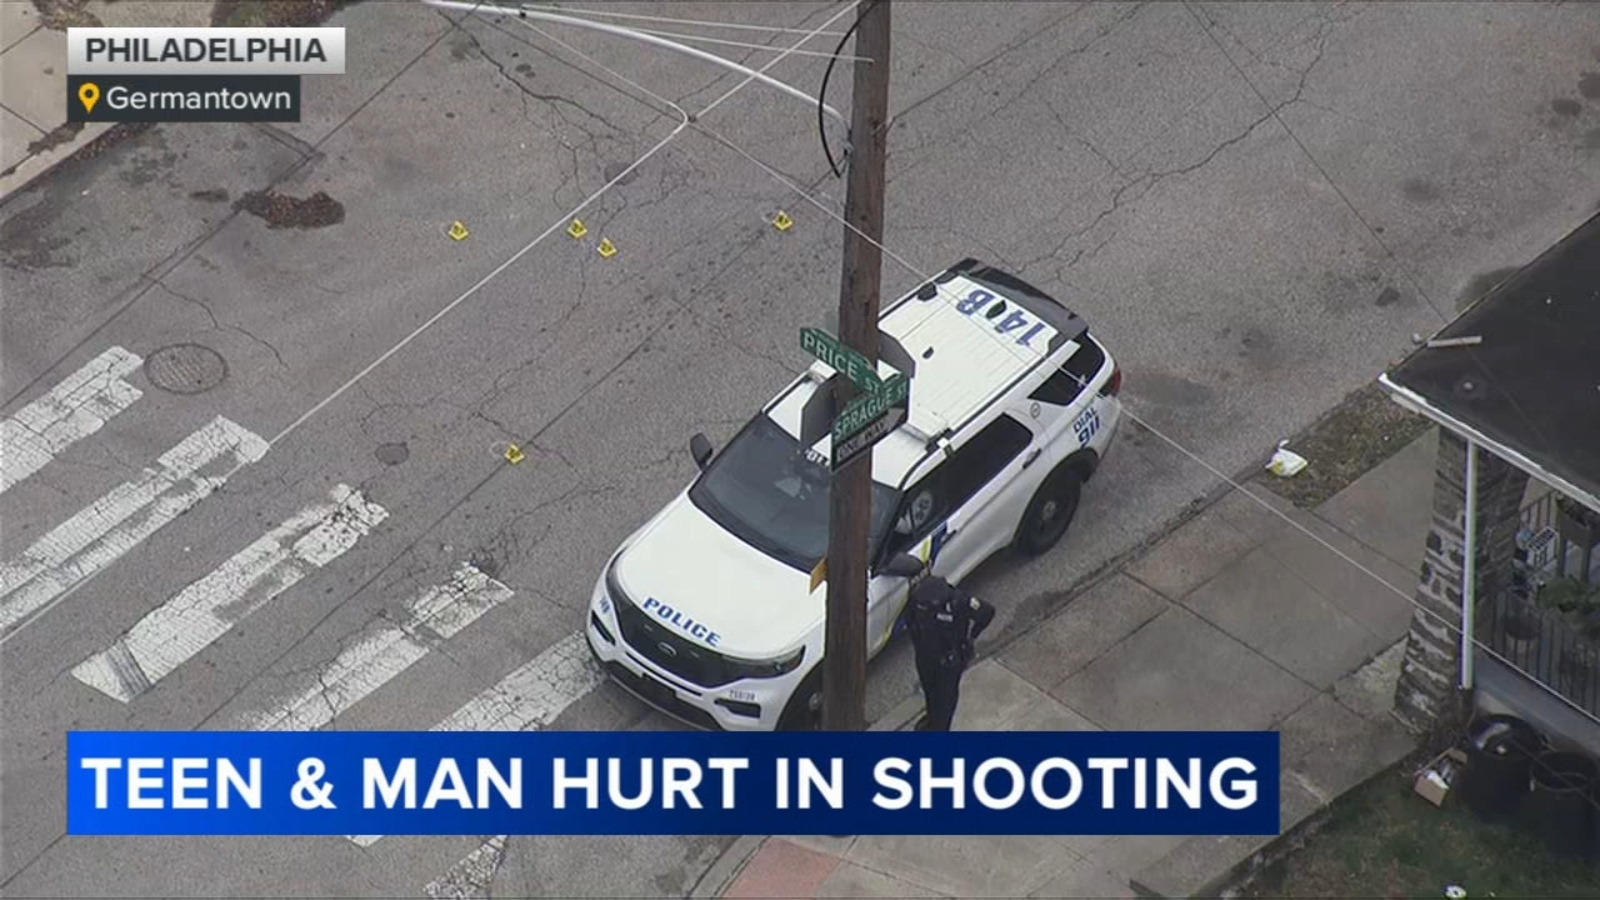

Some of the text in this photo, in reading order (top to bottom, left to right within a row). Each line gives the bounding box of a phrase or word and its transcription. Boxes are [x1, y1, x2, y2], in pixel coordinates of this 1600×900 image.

[803, 332, 858, 382] PRICE
[834, 386, 894, 441] SPRAGUE
[1073, 407, 1097, 433] DIAL
[1078, 415, 1100, 451] 911
[643, 597, 721, 648] POLICE
